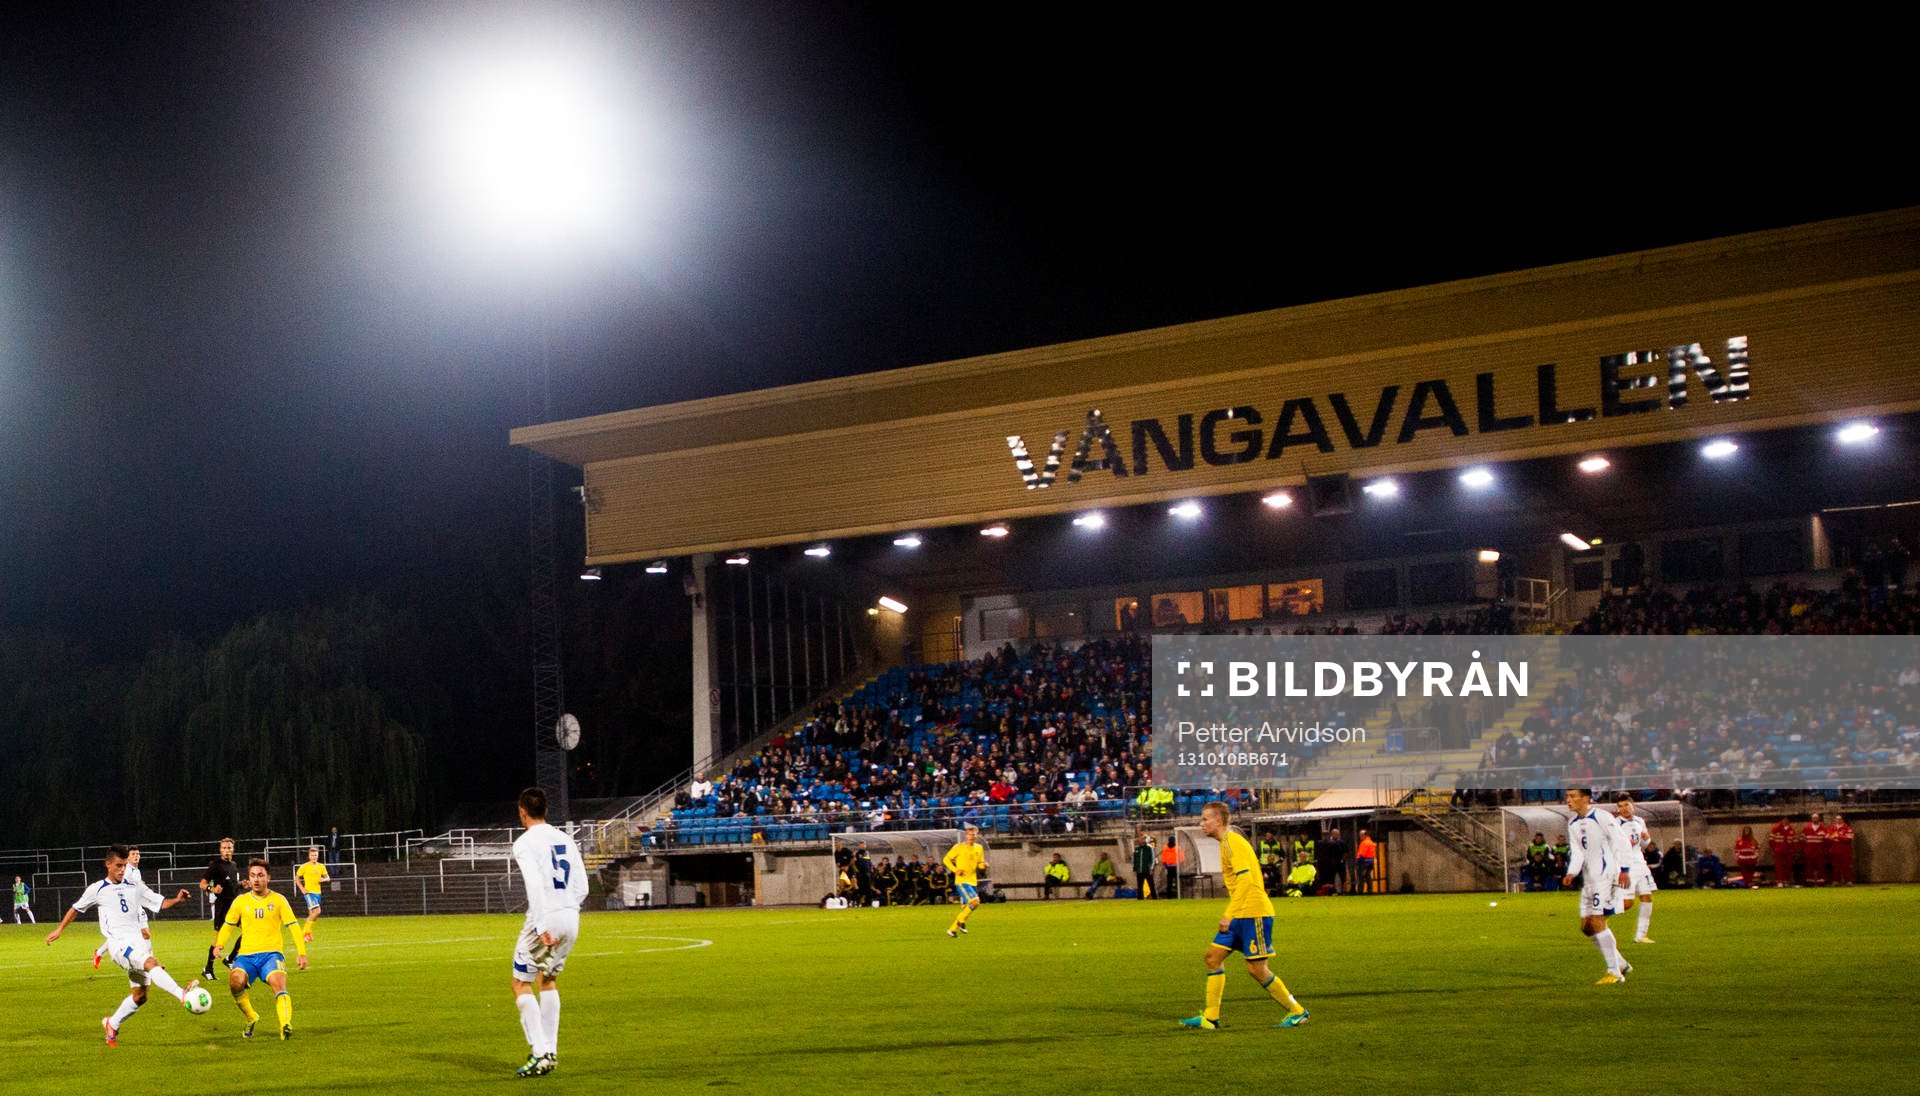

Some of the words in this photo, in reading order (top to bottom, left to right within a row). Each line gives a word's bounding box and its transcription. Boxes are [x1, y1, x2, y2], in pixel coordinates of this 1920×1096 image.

[1006, 335, 1750, 491] VÅNGAVALLEN
[550, 844, 571, 890] 5
[120, 898, 129, 913] 8
[1592, 892, 1601, 908] 6
[254, 908, 264, 919] 10
[1249, 939, 1258, 954] 6
